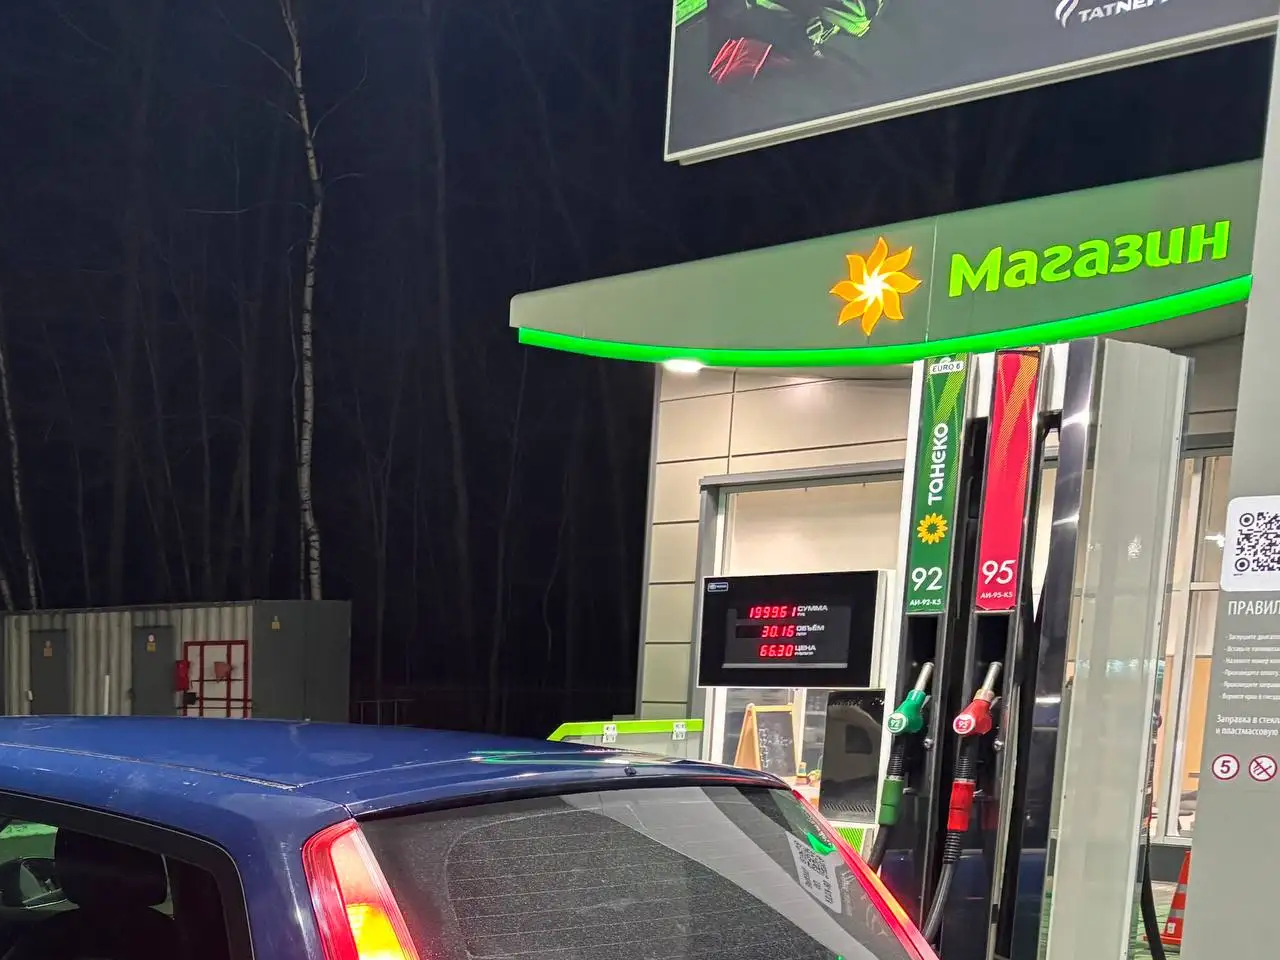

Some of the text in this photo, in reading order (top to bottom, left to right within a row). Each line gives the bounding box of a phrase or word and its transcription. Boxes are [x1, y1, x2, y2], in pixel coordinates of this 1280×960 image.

[1078, 0, 1169, 23] TATNE
[949, 220, 1230, 297] Магазин
[932, 363, 955, 373] EURO
[911, 566, 943, 592] 92
[982, 559, 1016, 585] 95
[1220, 760, 1231, 774] 5
